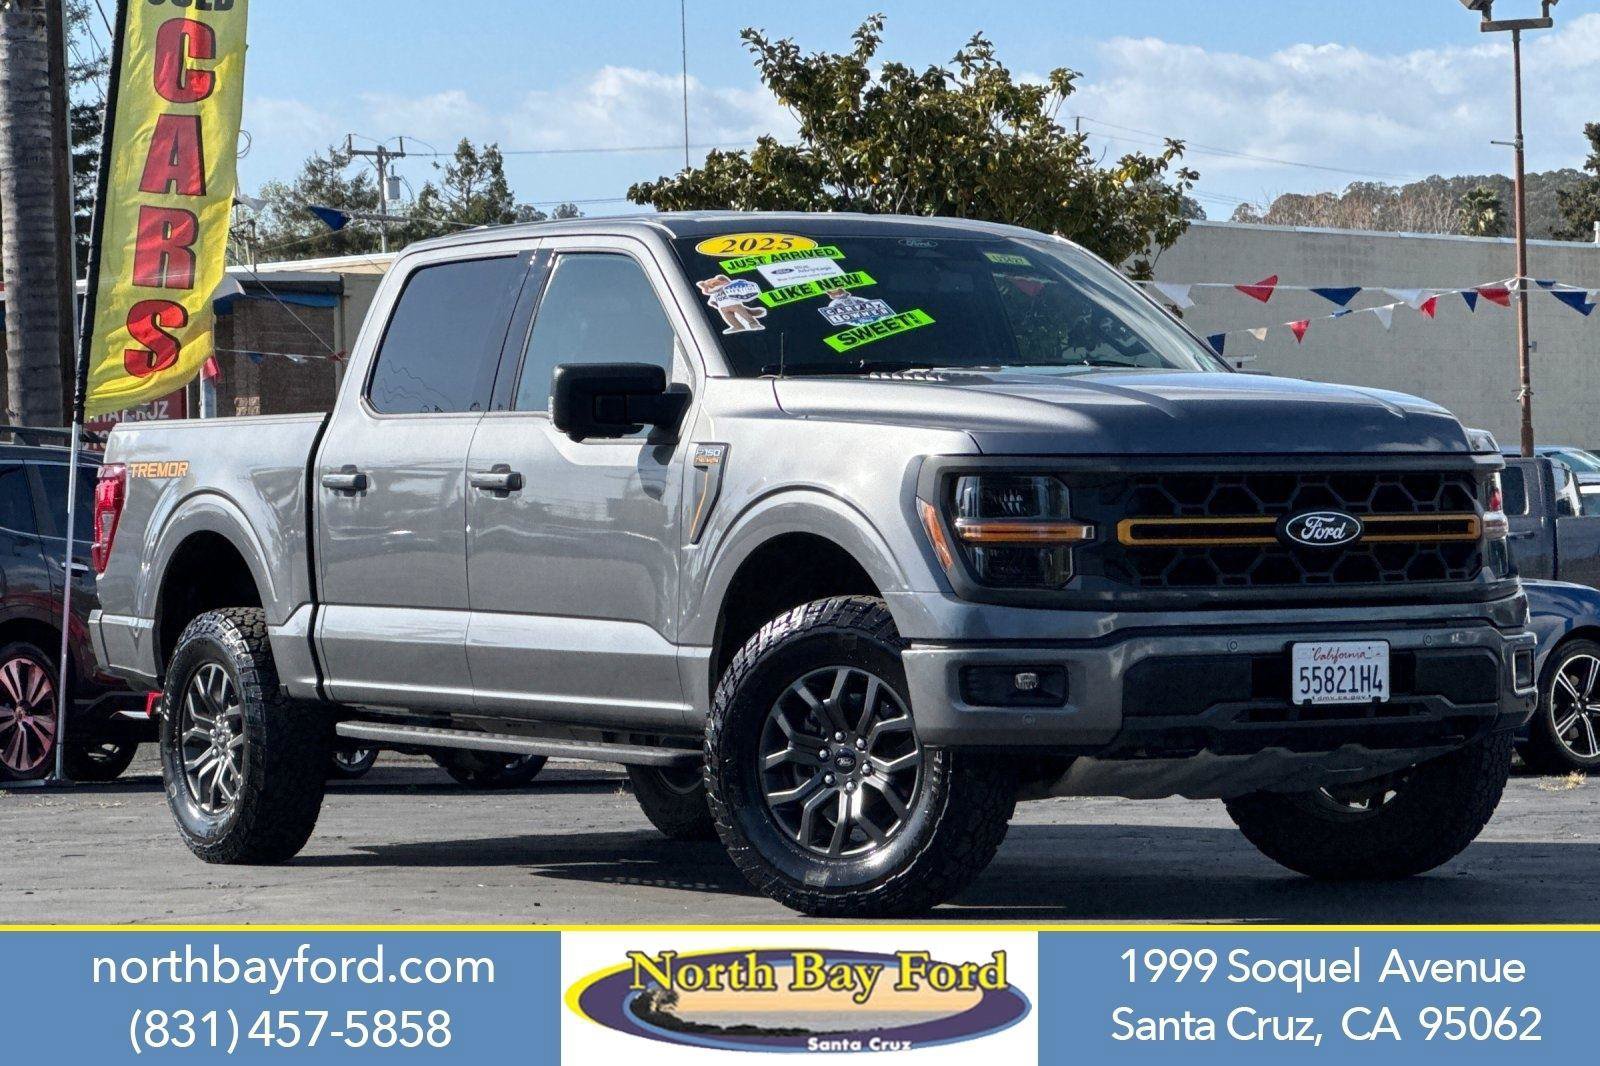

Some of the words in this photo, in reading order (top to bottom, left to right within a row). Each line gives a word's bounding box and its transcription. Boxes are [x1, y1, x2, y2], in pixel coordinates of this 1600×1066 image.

[123, 17, 217, 379] CARS
[720, 237, 795, 253] 2025
[727, 254, 767, 270] JUST
[770, 247, 838, 264] ARRIVED
[769, 283, 815, 303] LIKE
[818, 273, 864, 291] NEW
[836, 311, 923, 347] SWEET!
[130, 461, 190, 478] TREMOR
[1301, 516, 1347, 540] Ford
[1313, 646, 1366, 664] California
[1300, 665, 1384, 694] 55821H4
